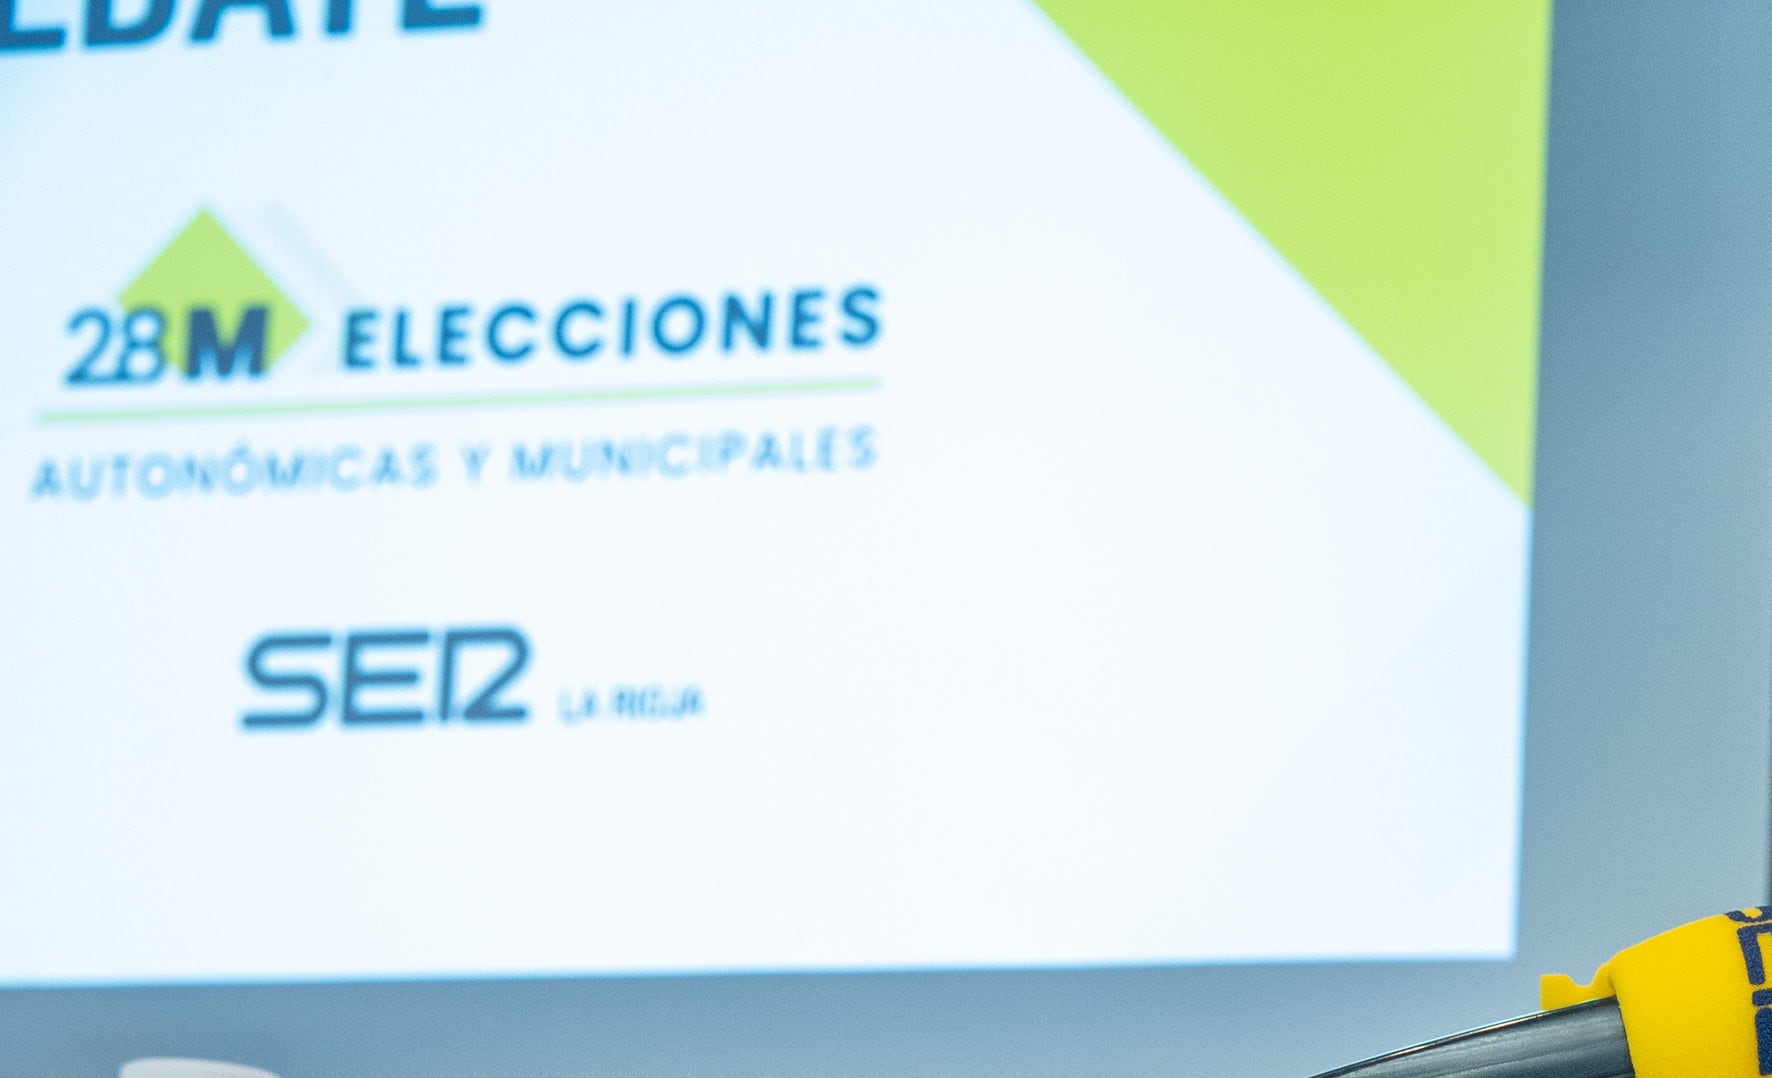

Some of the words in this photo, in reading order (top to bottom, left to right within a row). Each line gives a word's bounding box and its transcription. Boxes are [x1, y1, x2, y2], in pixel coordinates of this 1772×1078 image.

[64, 302, 272, 387] 28M
[341, 285, 881, 372] ELECCIONES
[29, 444, 437, 501] AUTONÓMICAS
[461, 446, 490, 480] Y
[509, 425, 878, 482] MUNICIPALES
[238, 625, 533, 732] SER
